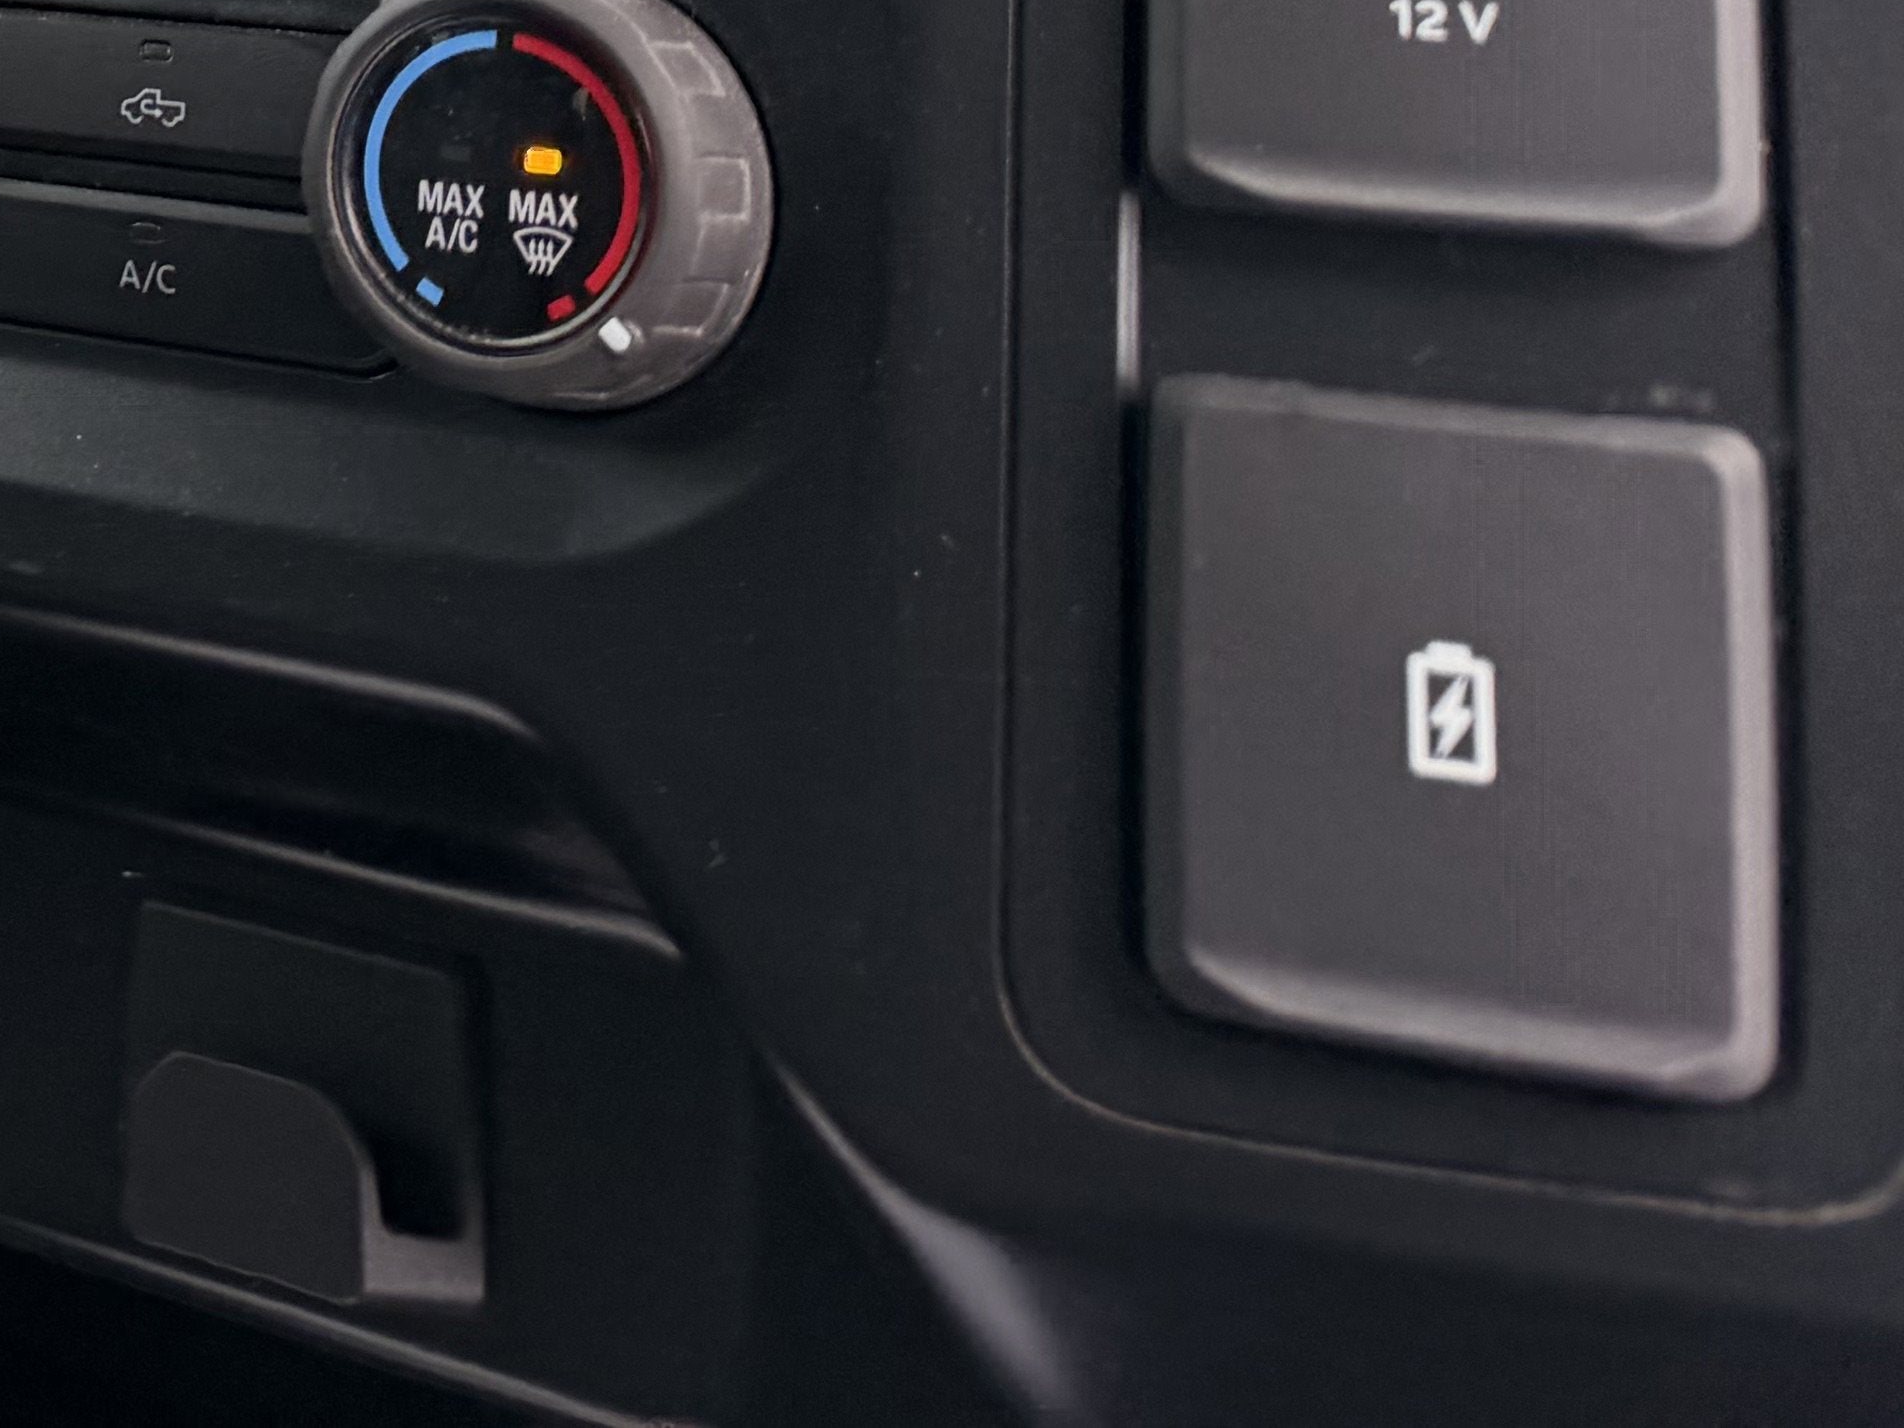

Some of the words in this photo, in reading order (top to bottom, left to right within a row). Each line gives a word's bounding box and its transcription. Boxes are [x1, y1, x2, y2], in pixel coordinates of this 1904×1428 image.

[1458, 0, 1500, 44] V
[418, 180, 484, 218] MAX
[508, 189, 578, 227] MAX
[426, 217, 479, 253] A/C
[119, 259, 177, 294] A/C
